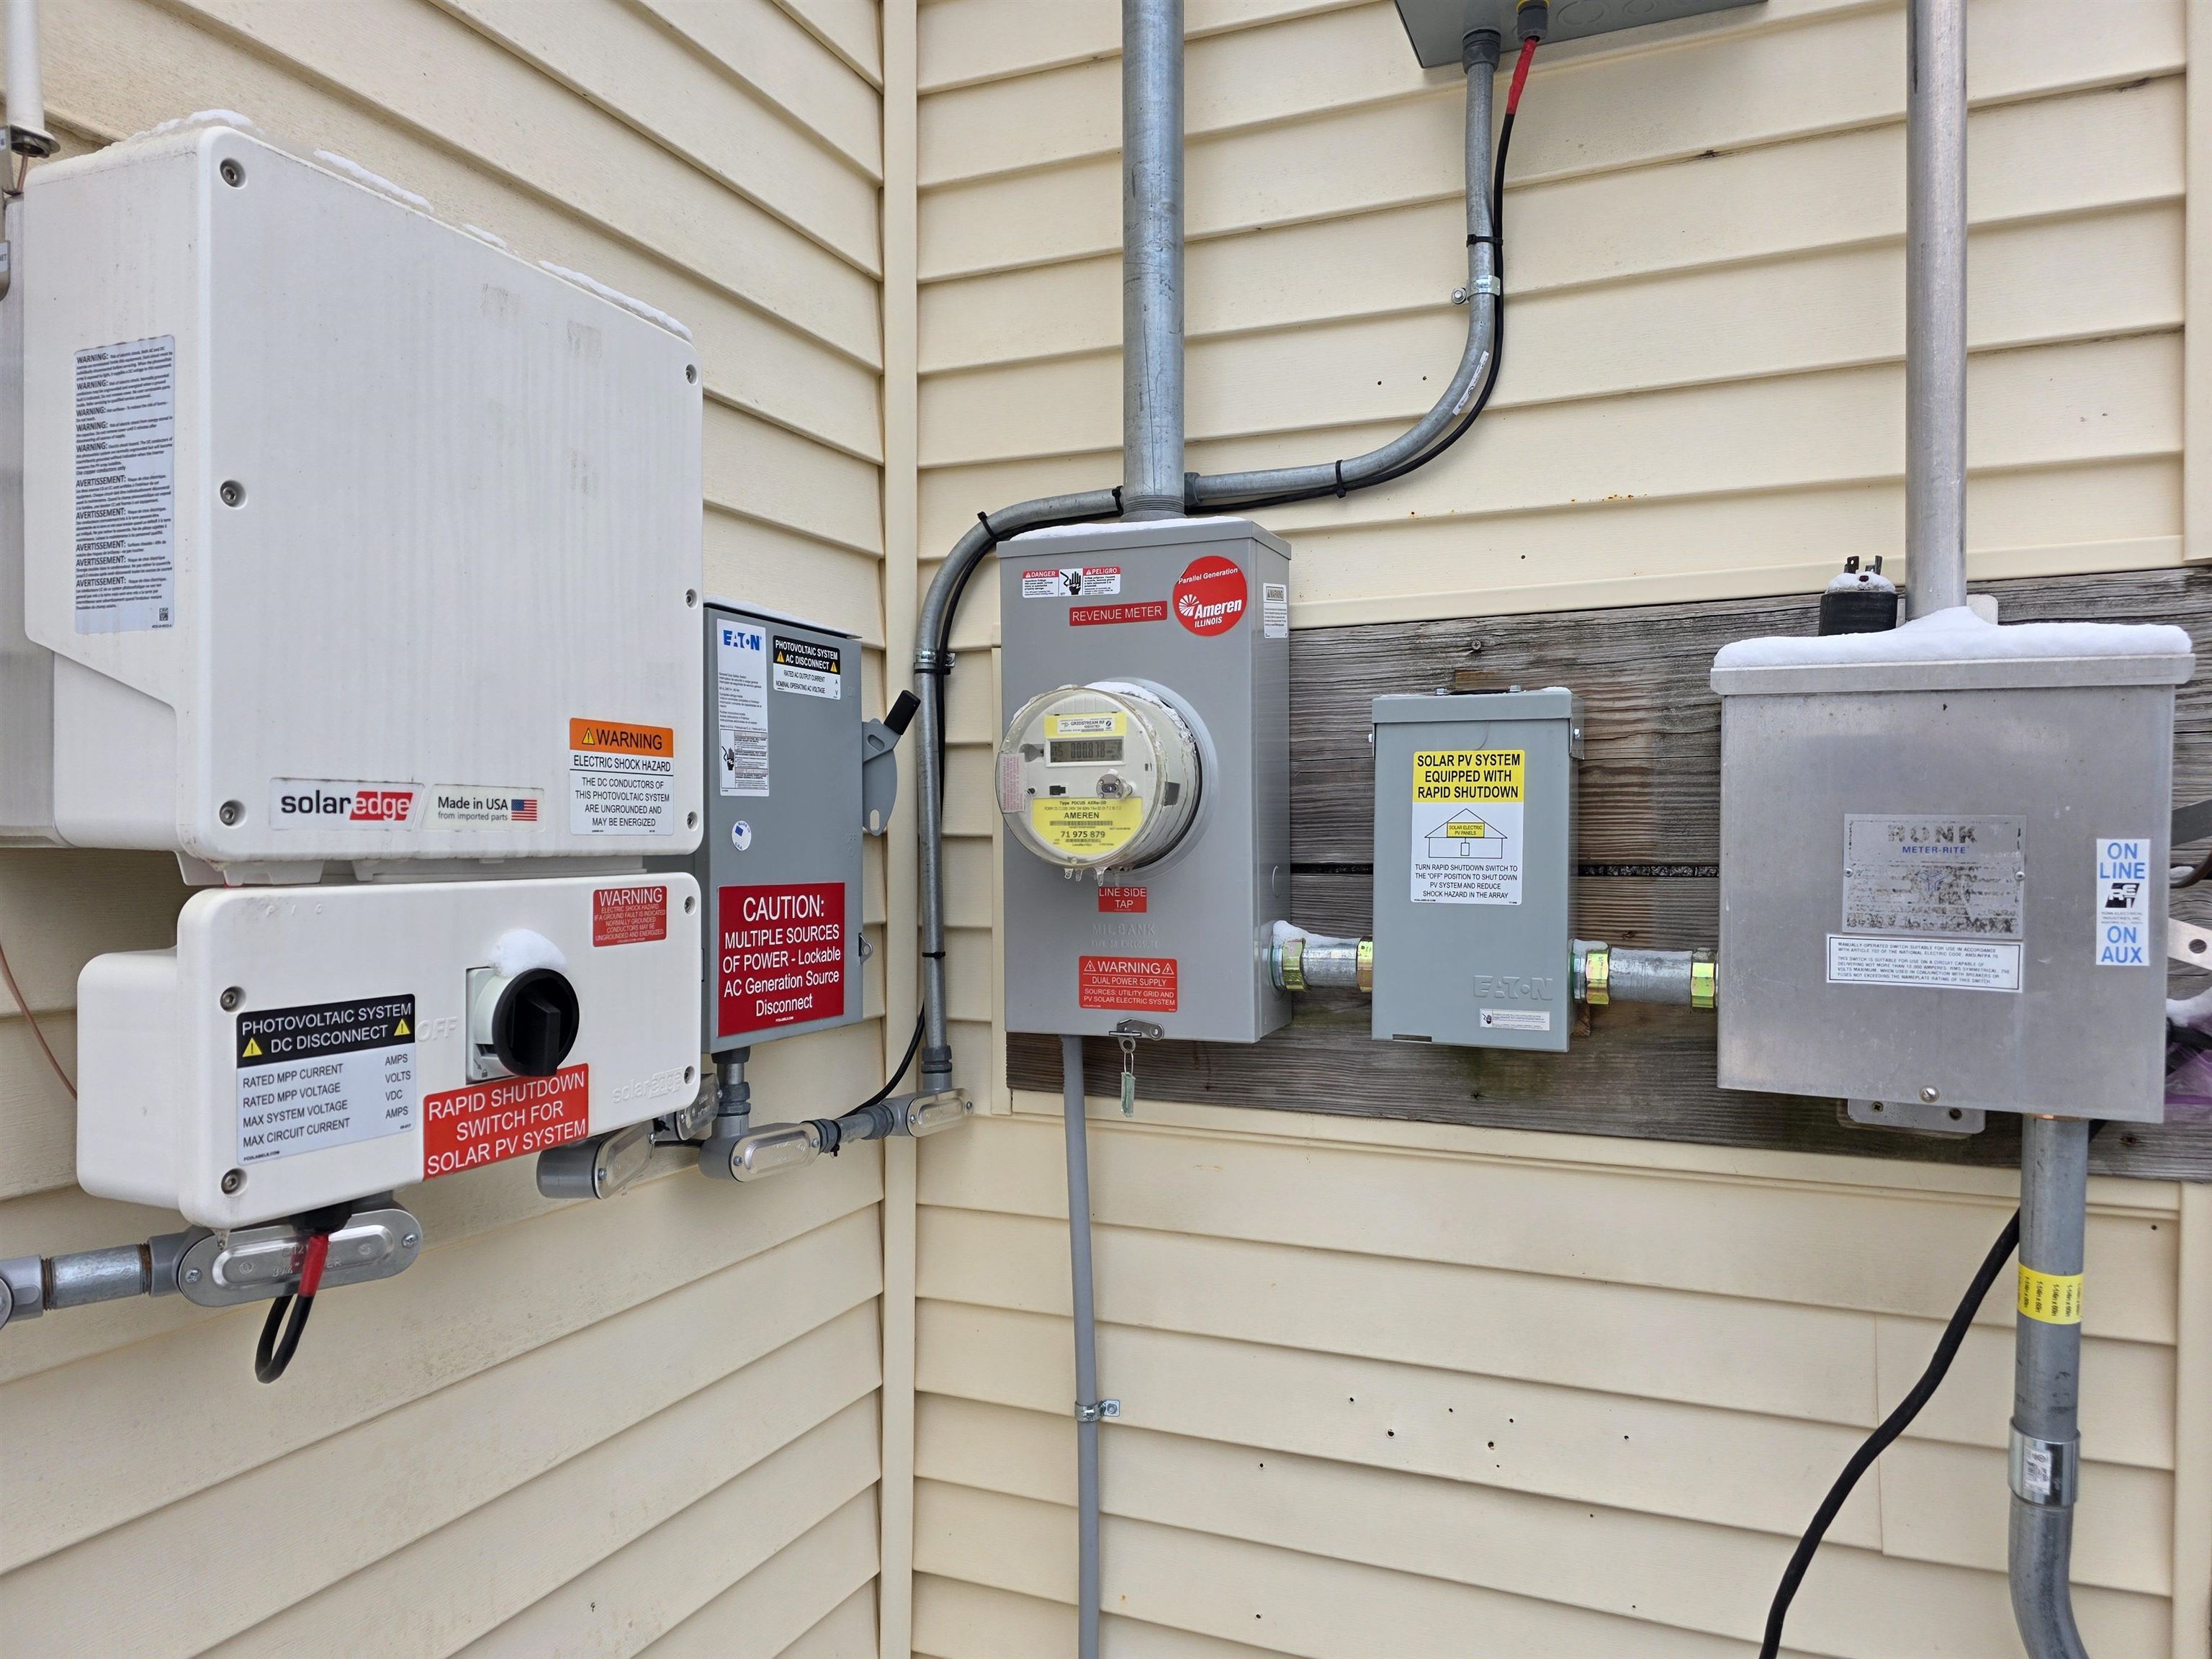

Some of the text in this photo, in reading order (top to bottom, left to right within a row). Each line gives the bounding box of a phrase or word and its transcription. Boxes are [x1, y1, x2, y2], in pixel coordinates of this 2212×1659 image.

[77, 353, 109, 364] WARNING:
[77, 379, 109, 390] WARNING:
[76, 407, 107, 417] WARNING:
[76, 421, 108, 432] WARNING:
[76, 442, 108, 452] WARNING:
[76, 475, 126, 487] AVERTISSEMENT:
[76, 508, 126, 520] AVERTISSEMENT:
[76, 540, 126, 552] AVERTISSEMENT:
[76, 555, 126, 567] AVERTISSEMENT:
[76, 576, 126, 588] AVERTISSEMENT:
[1178, 567, 1238, 585] Parallel Generation
[1072, 606, 1161, 621] REVENUE METER
[1195, 599, 1241, 619] Ameren
[1195, 616, 1222, 628] ILLINOIS
[775, 639, 838, 660] PHOTOVOLTAIC SYSTEM
[786, 654, 830, 670] AC DISCONNECT
[596, 729, 662, 750] WARNING
[574, 755, 671, 772] ELECTRIC SHOCK HAZARD
[1417, 754, 1520, 767] SOLAR PV SYSTEM
[582, 777, 595, 786] THE
[598, 778, 607, 787] DC
[609, 778, 654, 789] CONDUCTORS
[1425, 770, 1511, 783] EQUIPPED WITH
[575, 790, 670, 801] THIS PHOTOVOLTAIC SYSTEM
[1418, 786, 1519, 799] RAPID SHUTDOWN
[281, 790, 410, 820] solaredge
[438, 796, 508, 811] Made in USA
[601, 804, 647, 814] UNGROUNDED
[438, 811, 508, 822] from imported parts
[593, 817, 607, 826] MAY
[619, 818, 655, 827] ENERGIZED
[2108, 842, 2137, 859] ON
[2100, 862, 2145, 879] LINE
[599, 888, 662, 907] WARNING
[1099, 887, 1146, 897] LINE SIDE
[743, 894, 824, 922] CAUTION:
[1115, 900, 1133, 909] TAP
[725, 924, 840, 949] MULTIPLE SOURCES
[2108, 925, 2136, 944] ON
[723, 956, 740, 974] OF
[744, 951, 788, 971] POWER
[799, 946, 841, 965] Lockable
[2100, 946, 2142, 963] AUX
[1097, 961, 1161, 974] WARNING
[724, 970, 840, 997] AC Generation Source
[1140, 978, 1166, 987] SUPPLY
[756, 994, 812, 1017] Disconnect
[242, 1003, 411, 1036] PHOTOVOLTAIC SYSTEM
[416, 1017, 458, 1043] OFF
[271, 1025, 388, 1054] DC DISCONNECT
[243, 1053, 408, 1089] RATED MPP CURRENT AMPS
[243, 1071, 410, 1108] RATED MPP VOLTAGE VOLTS
[428, 1071, 585, 1121] RAPID SHUTDOWN
[243, 1089, 403, 1128] MAX SYSTEM VOLTAGE VDC
[243, 1107, 408, 1148] MAX CIRCUIT CURRENT AMPS
[456, 1102, 563, 1142] SWITCH FOR
[427, 1119, 586, 1175] SOLAR PV SYSTEM
